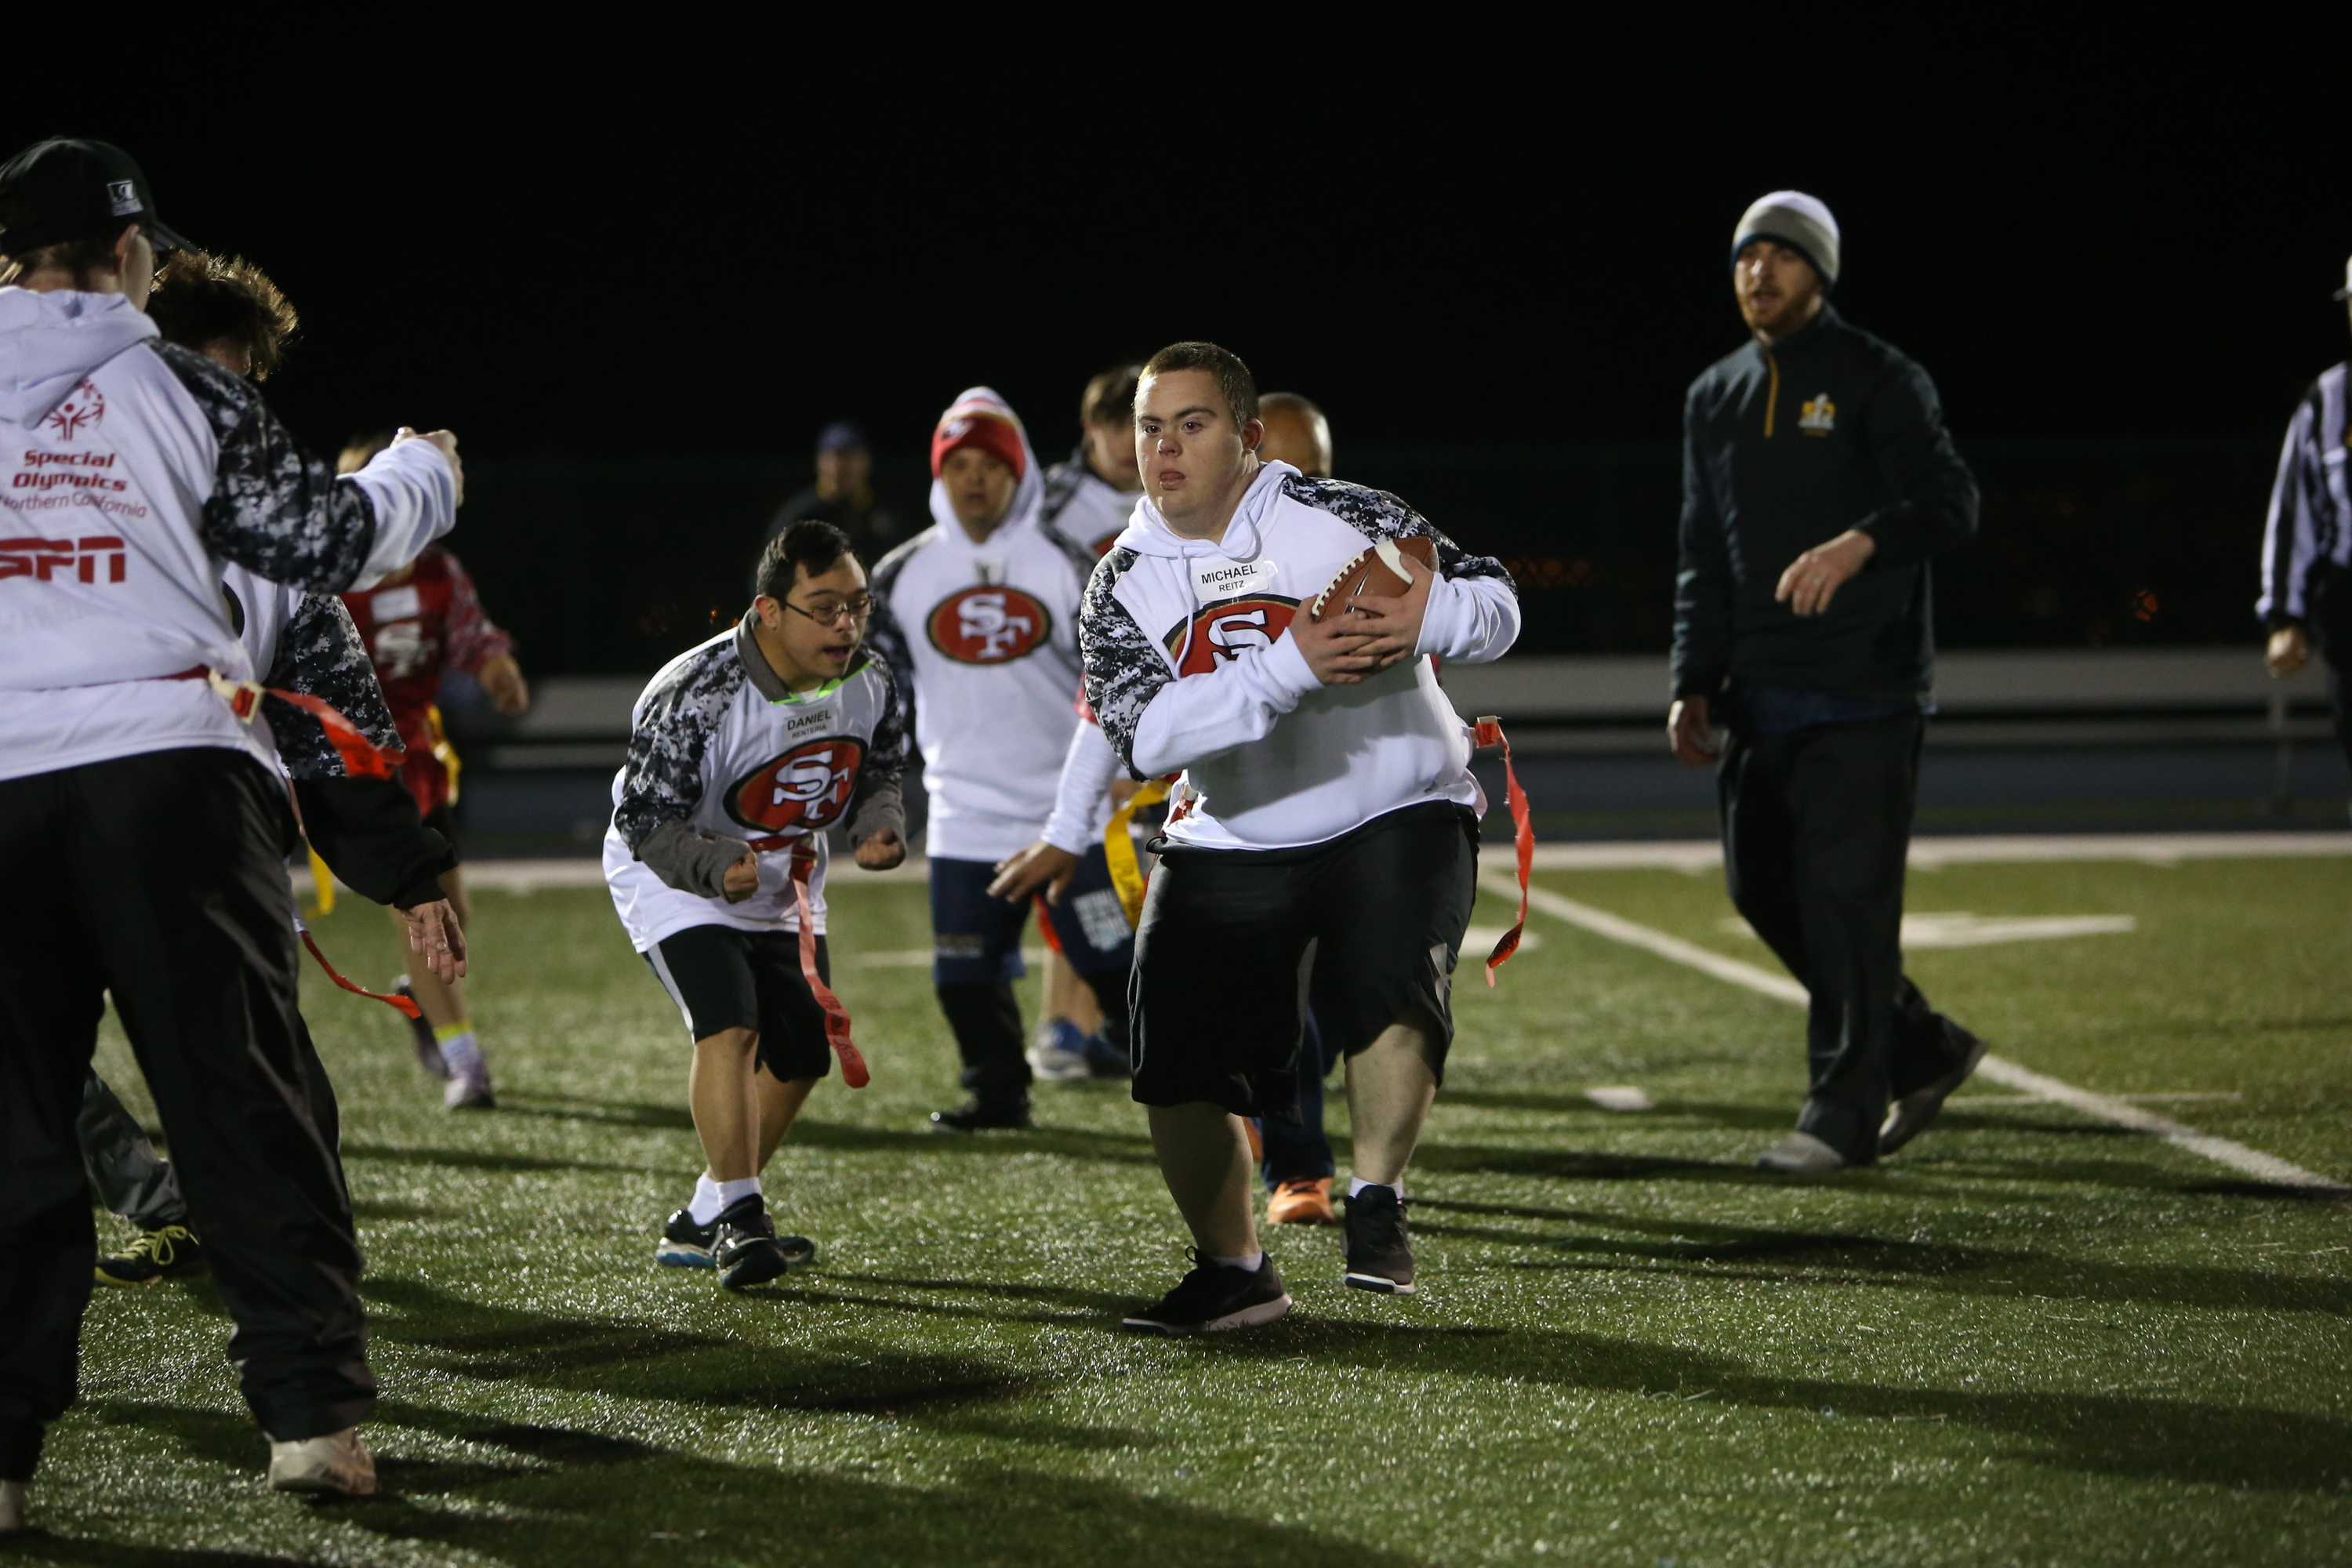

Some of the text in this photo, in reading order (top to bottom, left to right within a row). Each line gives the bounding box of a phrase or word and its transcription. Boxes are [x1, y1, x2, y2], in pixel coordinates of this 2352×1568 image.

[24, 449, 116, 468] Special
[13, 472, 128, 492] Olympics
[71, 491, 149, 517] Cafornia
[0, 536, 125, 585] SPN
[1201, 564, 1258, 584] MICHAEL
[1218, 580, 1244, 592] REITZ
[957, 593, 1032, 659] SF
[787, 709, 832, 731] DANIEL
[772, 750, 849, 820] SF
